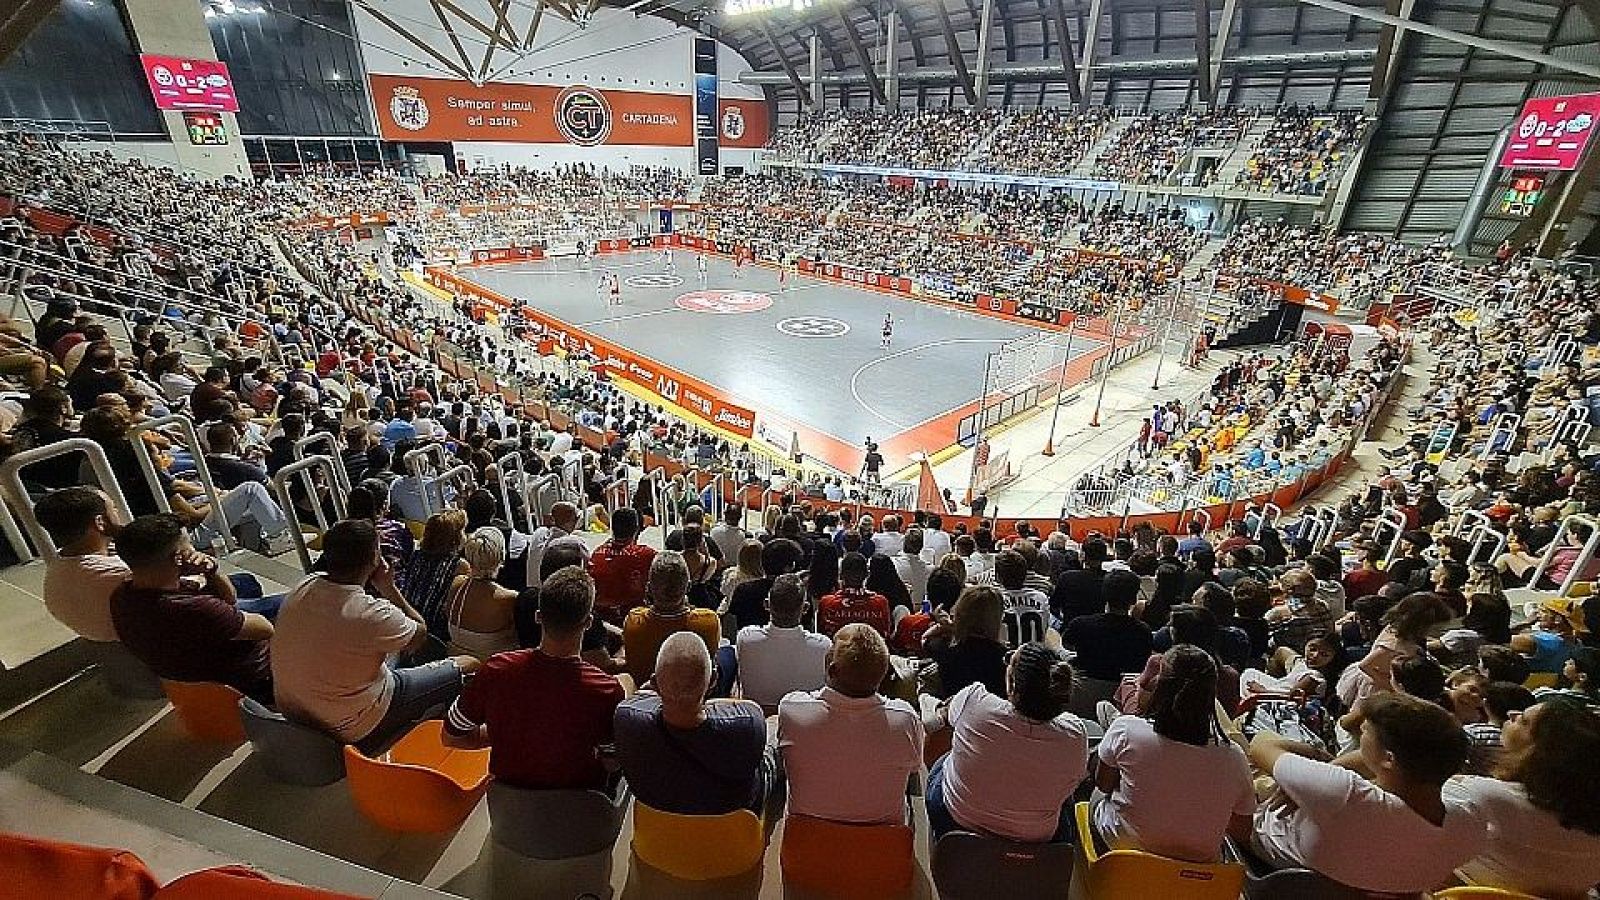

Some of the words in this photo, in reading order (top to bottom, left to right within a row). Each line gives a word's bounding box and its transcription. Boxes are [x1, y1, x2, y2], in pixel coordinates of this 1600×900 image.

[447, 96, 496, 111] Semper
[467, 114, 483, 126] ad
[622, 113, 678, 125] CARTAGENA
[1001, 611, 1043, 647] 10
